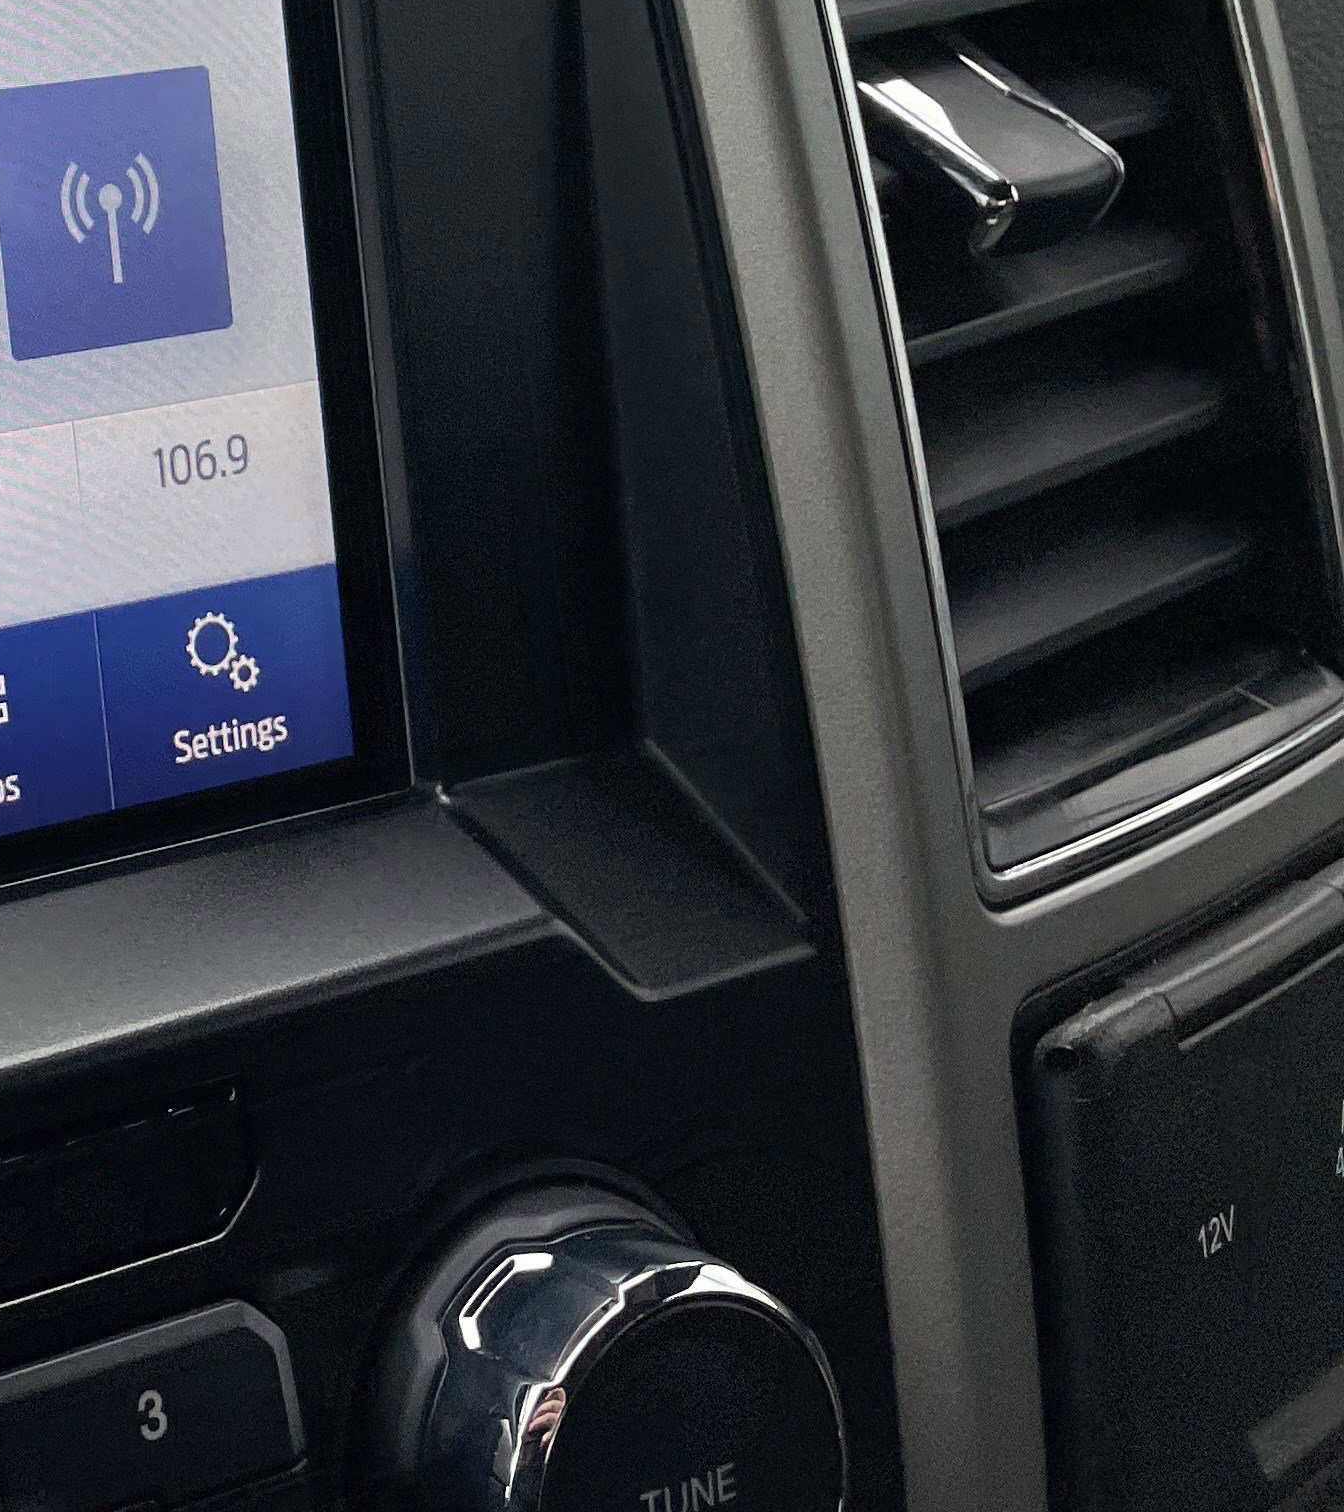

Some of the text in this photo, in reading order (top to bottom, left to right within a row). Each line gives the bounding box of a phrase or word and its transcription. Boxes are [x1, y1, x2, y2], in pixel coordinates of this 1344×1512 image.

[152, 433, 250, 488] 106.9
[173, 713, 289, 765] Settings
[1198, 1204, 1235, 1258] 12V
[137, 1390, 168, 1441] 3
[639, 1462, 737, 1512] TUNE
